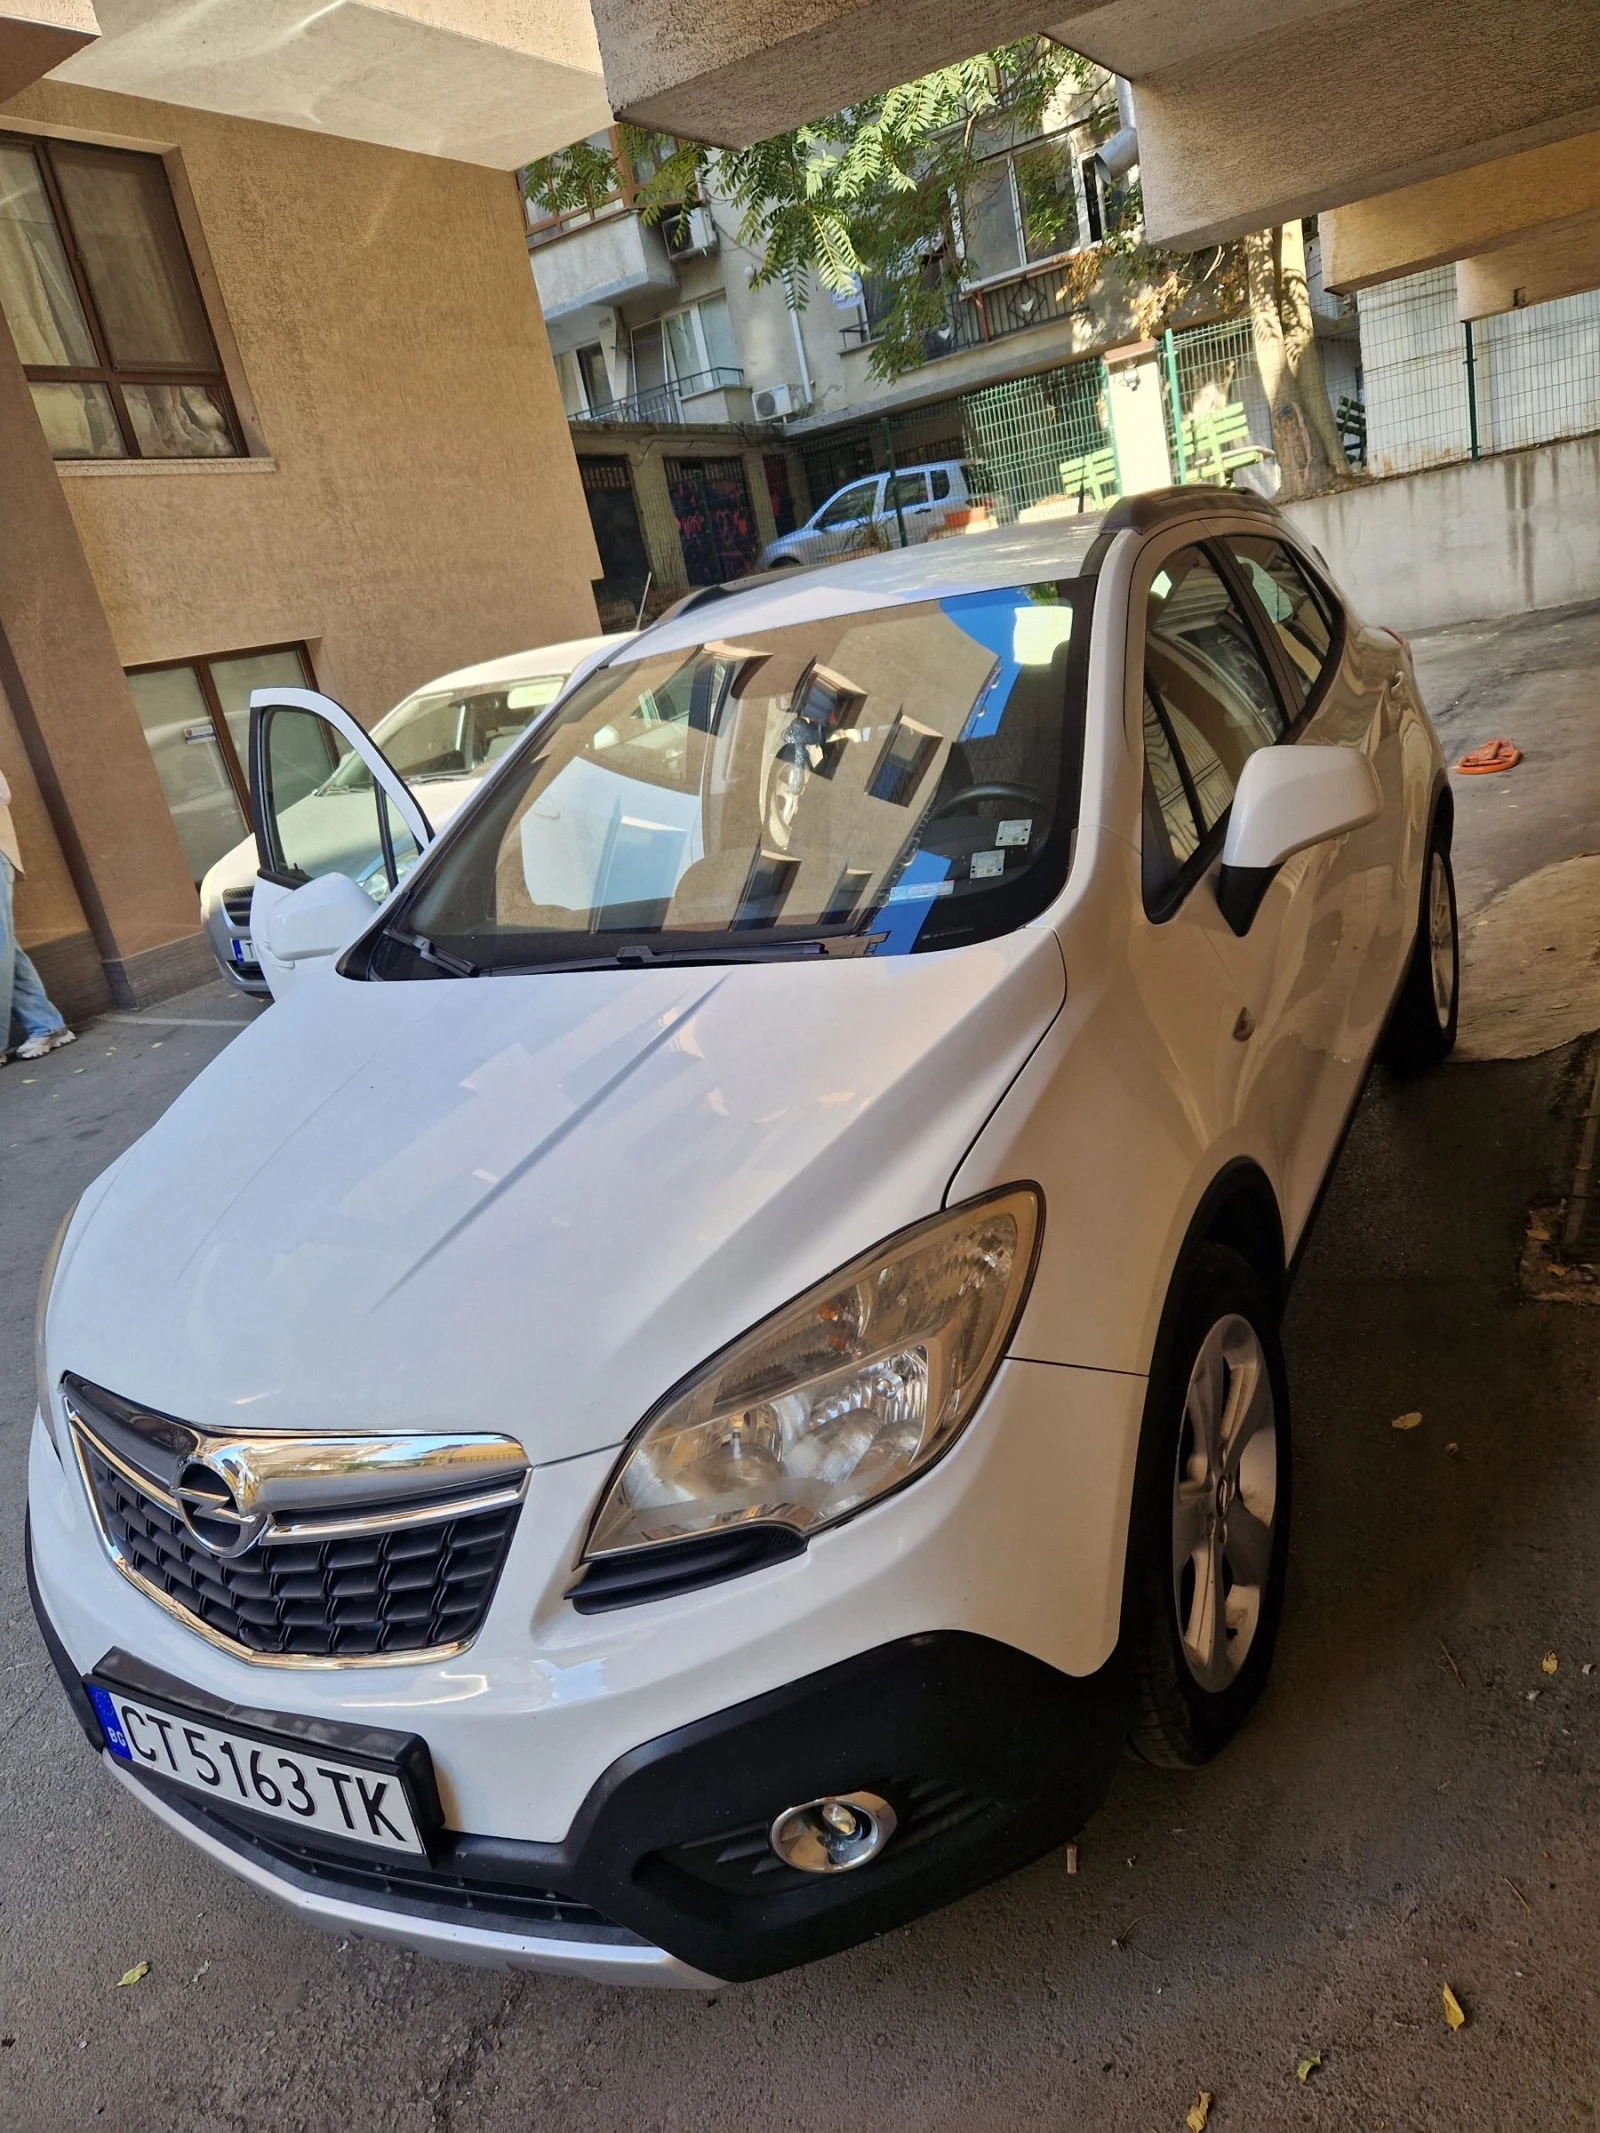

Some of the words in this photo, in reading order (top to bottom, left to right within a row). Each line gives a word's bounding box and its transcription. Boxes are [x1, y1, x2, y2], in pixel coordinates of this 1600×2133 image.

[107, 1726, 126, 1747] BG
[121, 1705, 179, 1772] CT
[182, 1727, 316, 1817] 5163
[316, 1767, 407, 1842] TK
